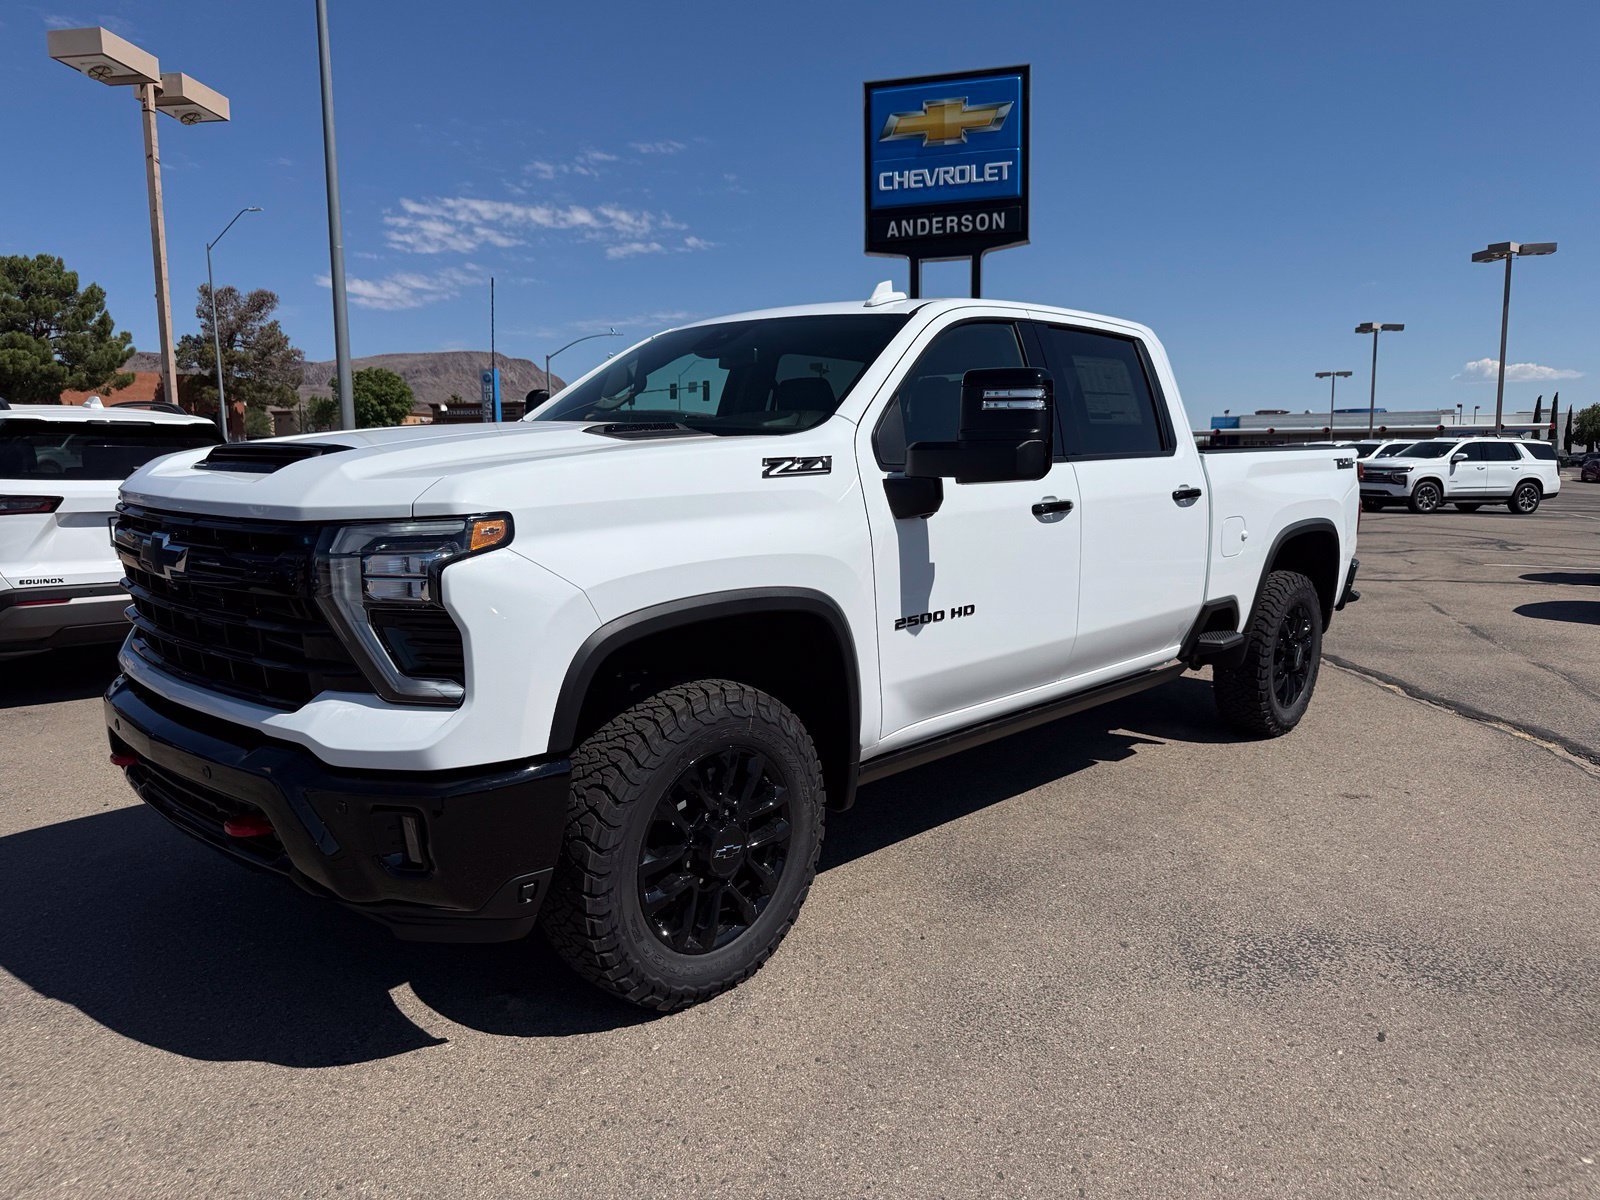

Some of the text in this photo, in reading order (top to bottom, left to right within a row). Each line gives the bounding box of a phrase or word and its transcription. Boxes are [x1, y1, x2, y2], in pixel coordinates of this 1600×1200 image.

[879, 161, 1012, 191] CHEVROLET
[887, 212, 1006, 238] ANDERSON
[762, 455, 832, 479] Z71
[895, 604, 975, 631] 2500 HD
